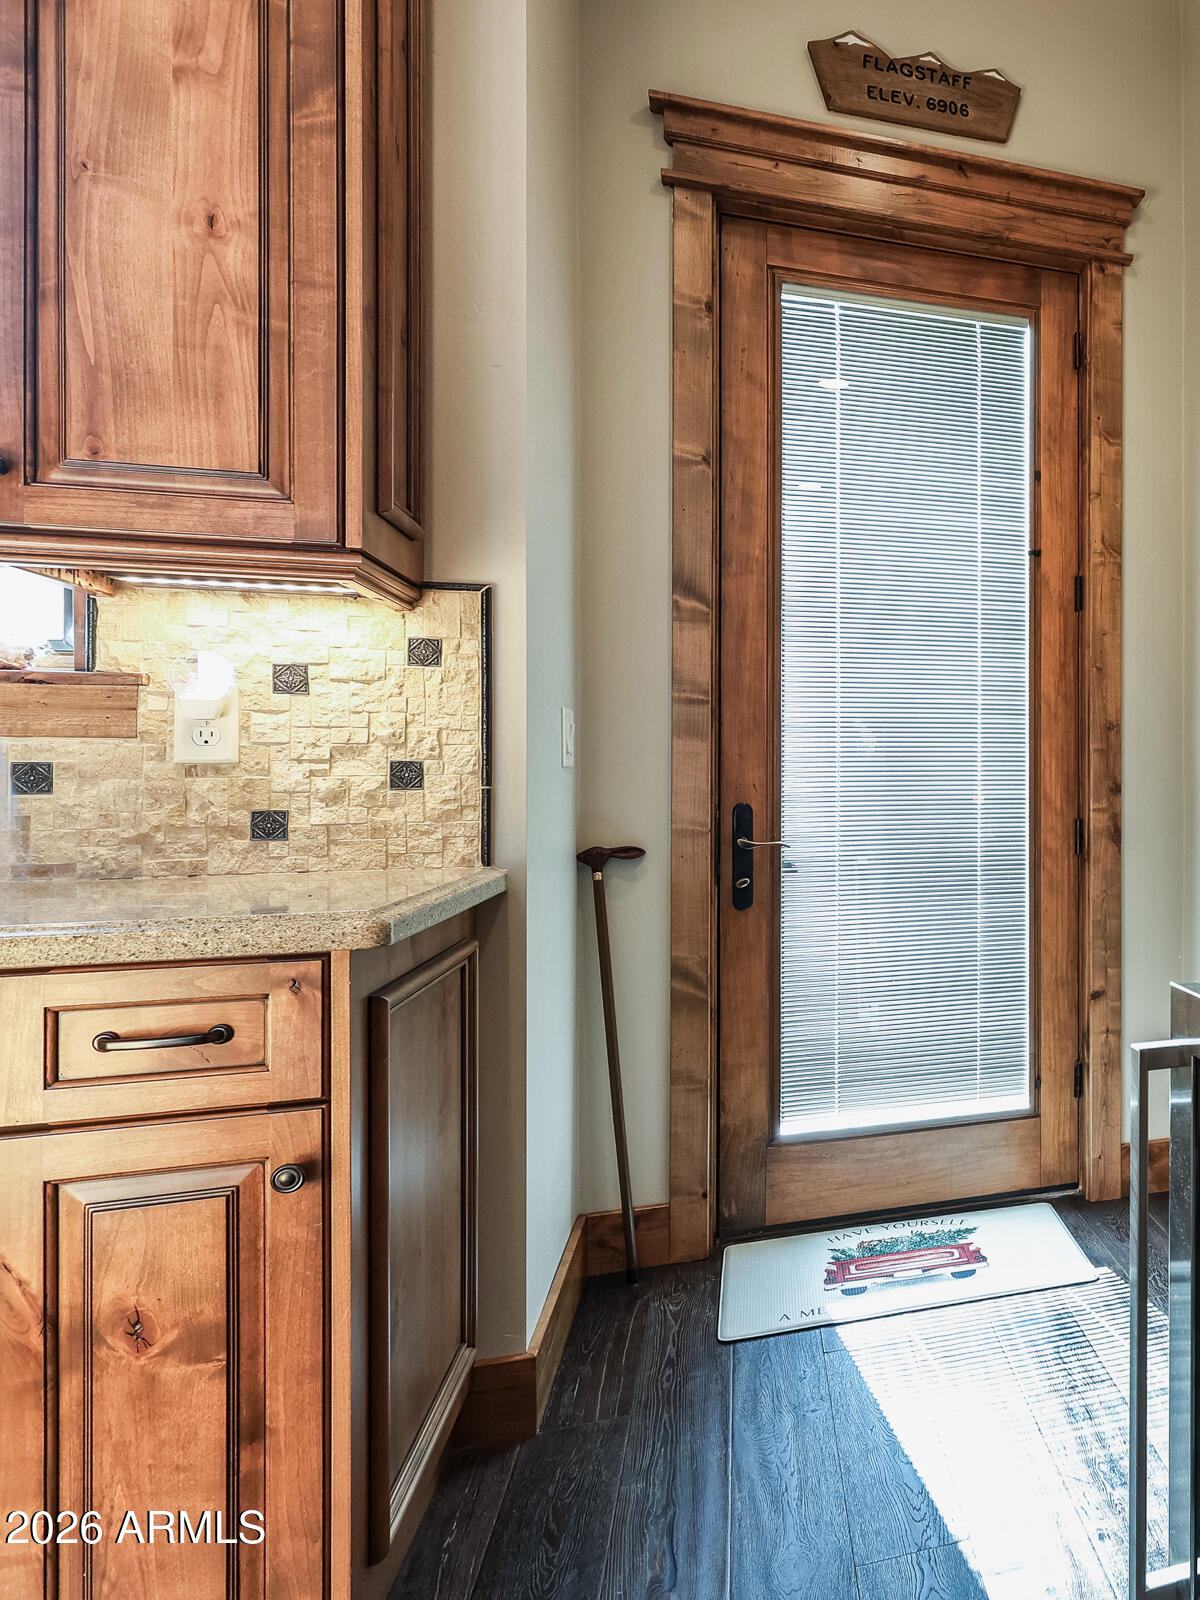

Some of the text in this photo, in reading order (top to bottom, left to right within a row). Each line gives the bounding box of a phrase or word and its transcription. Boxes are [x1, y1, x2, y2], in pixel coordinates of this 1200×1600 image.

[862, 54, 973, 90] FLAGSTAFF
[866, 85, 970, 117] ELEV. 6906
[827, 1218, 969, 1244] HAVE YOURSELF
[779, 1313, 791, 1322] A
